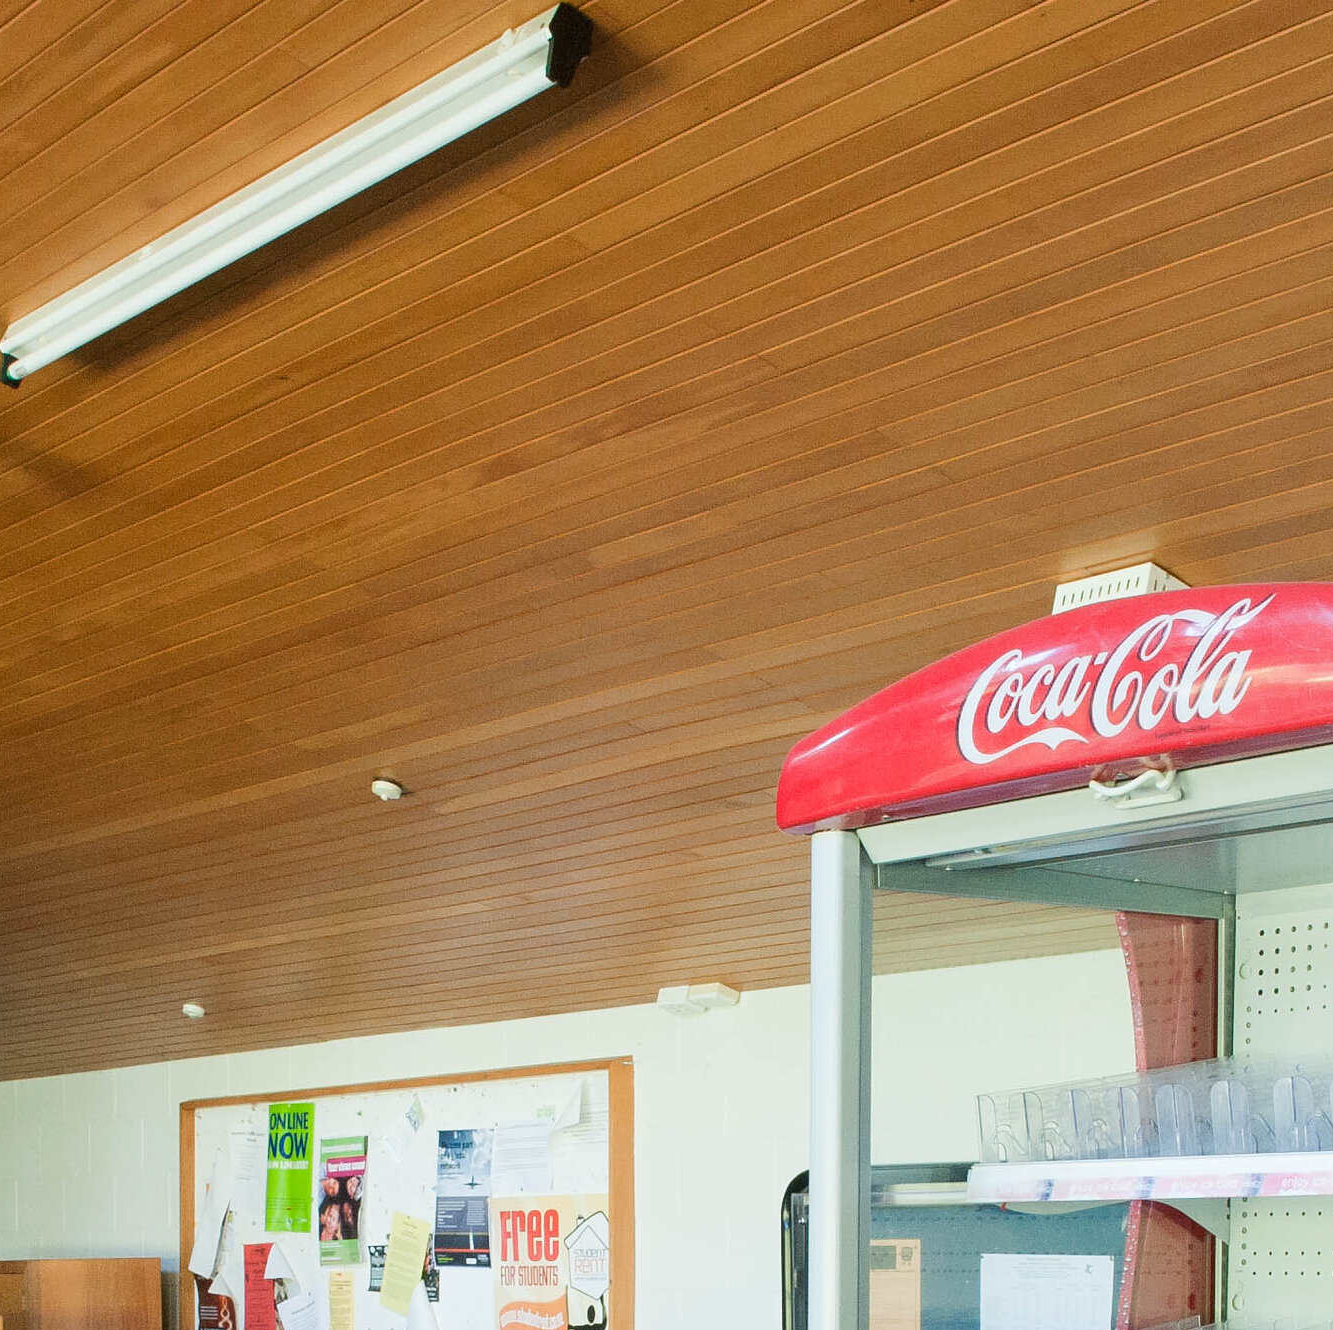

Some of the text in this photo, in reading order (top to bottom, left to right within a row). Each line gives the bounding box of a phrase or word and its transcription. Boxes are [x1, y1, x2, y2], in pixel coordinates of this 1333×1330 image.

[956, 592, 1276, 765] Coca-Cola
[267, 1132, 309, 1160] NOW
[1282, 1176, 1309, 1188] enjoy
[500, 1265, 559, 1286] FOR STUDENTS
